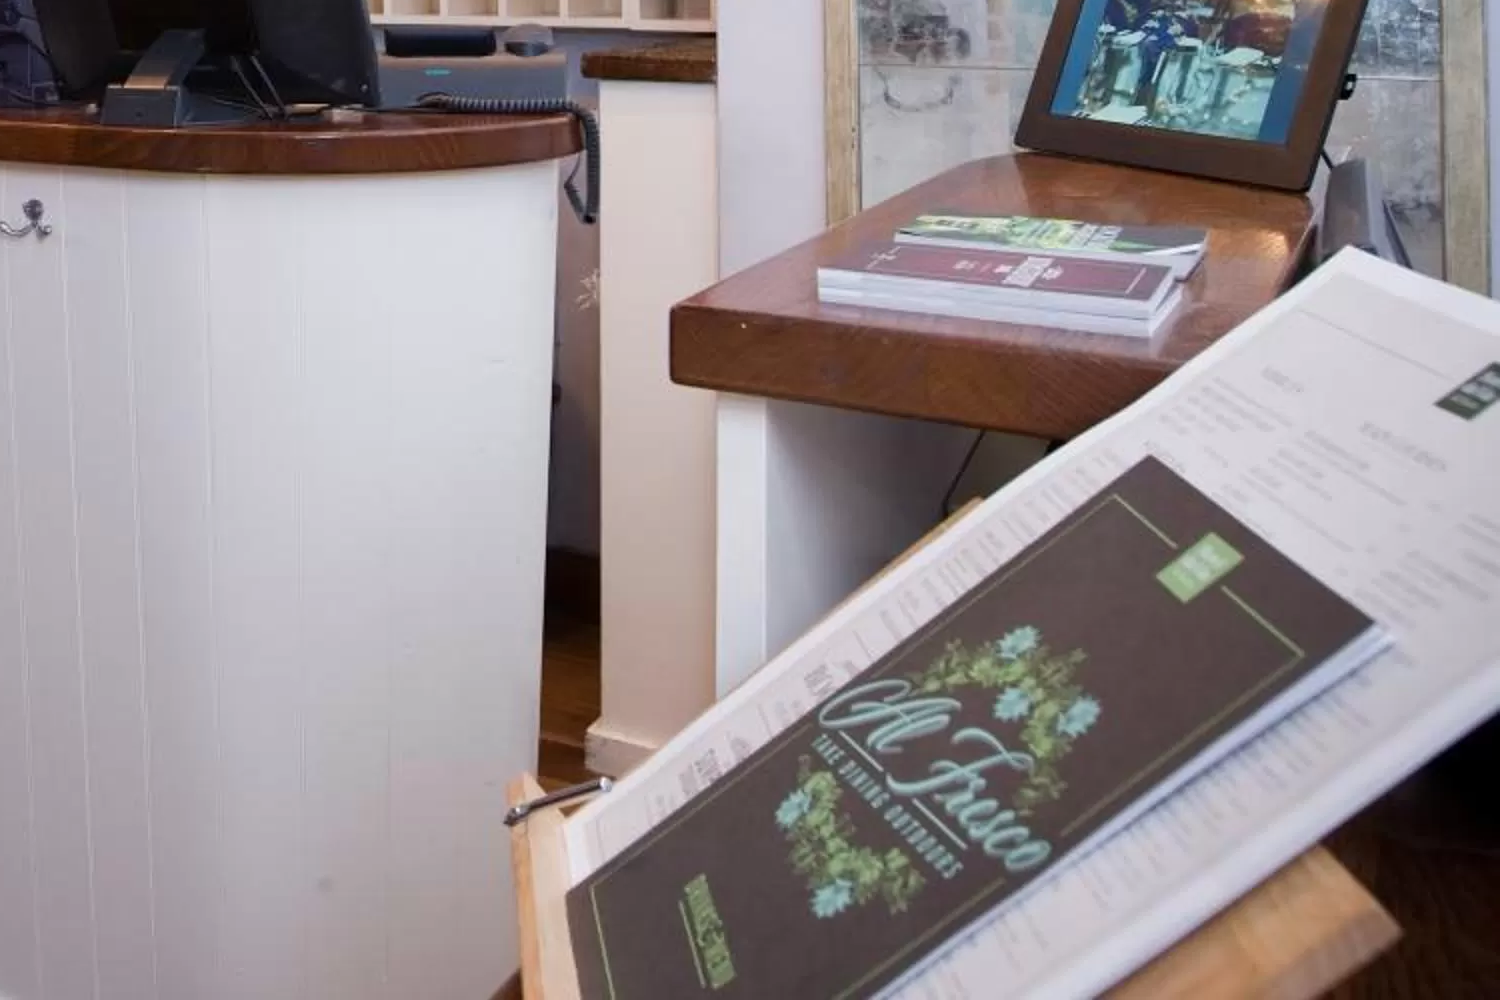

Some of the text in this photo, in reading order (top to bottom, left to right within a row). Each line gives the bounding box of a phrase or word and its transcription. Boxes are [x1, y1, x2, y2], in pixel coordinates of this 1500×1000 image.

[819, 679, 962, 752] Al
[811, 734, 964, 879] TAKE DINING OUTDOORS
[886, 727, 1052, 872] Fresco
